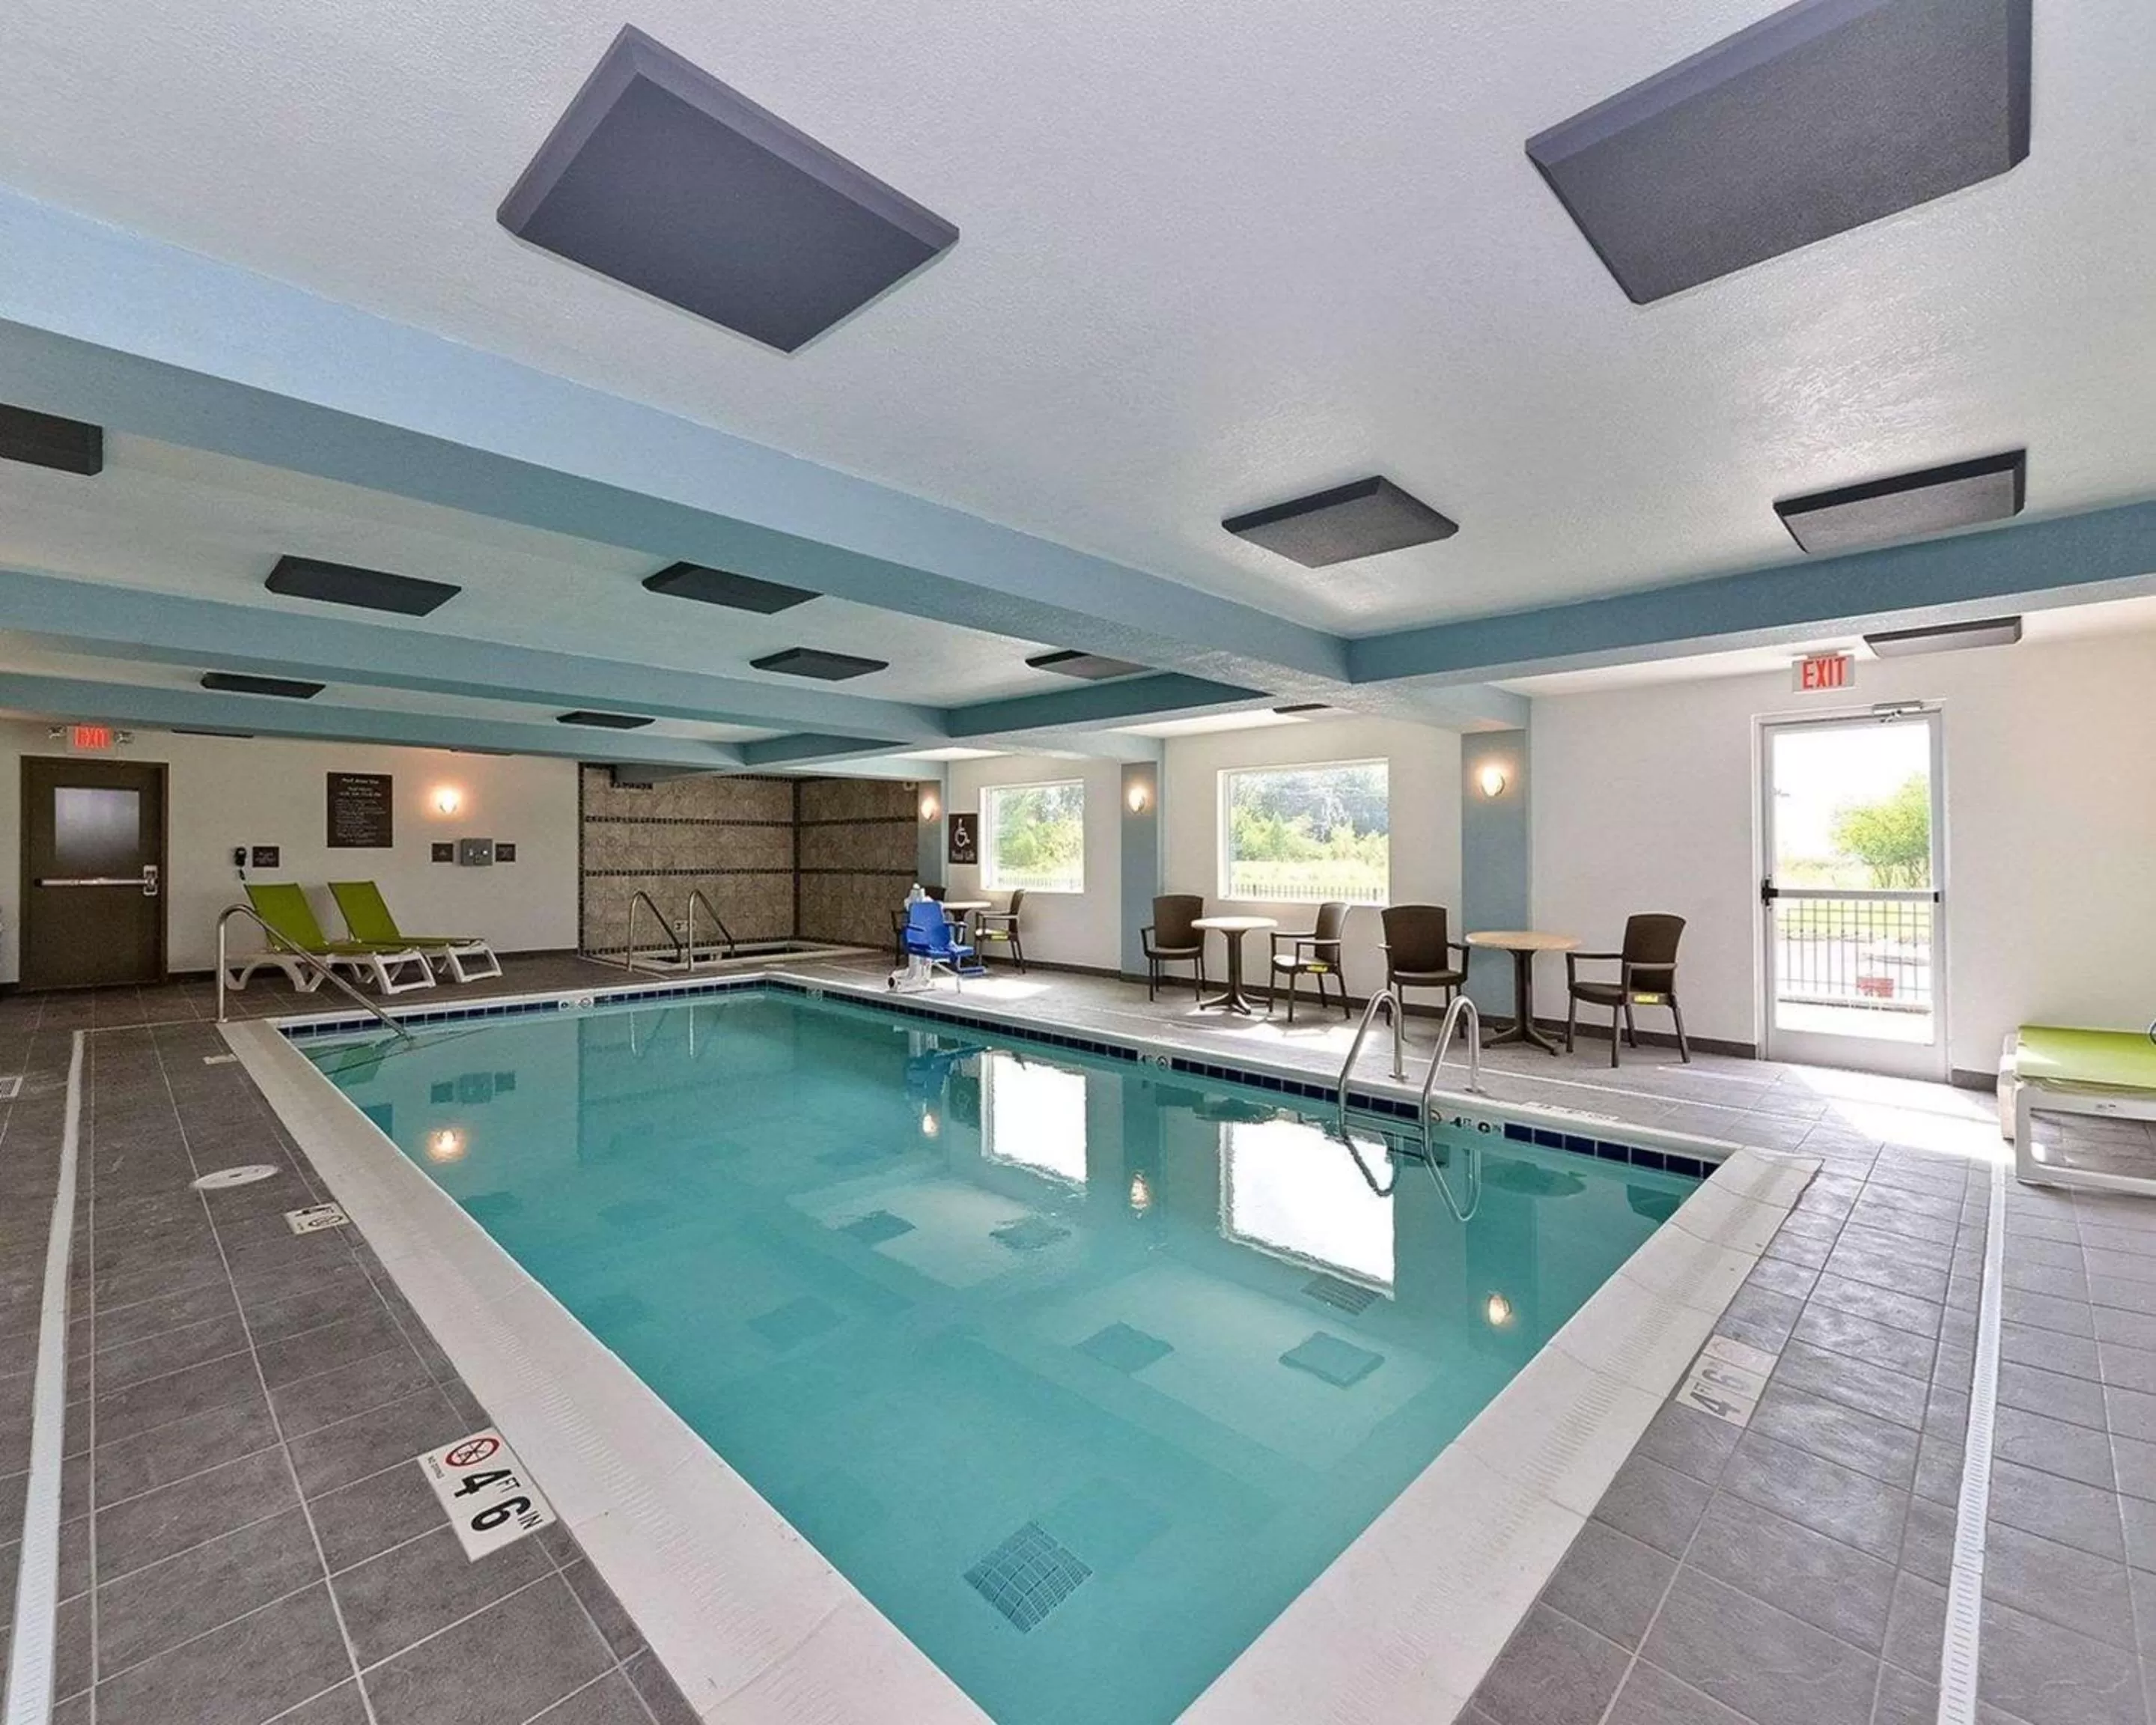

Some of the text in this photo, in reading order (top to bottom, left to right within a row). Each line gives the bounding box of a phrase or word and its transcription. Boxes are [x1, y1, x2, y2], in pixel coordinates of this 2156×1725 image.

[1802, 657, 1846, 689] EXIT
[75, 726, 109, 748] EXIT
[1690, 1391, 1741, 1417] 4
[454, 1469, 544, 1532] 4 FT 6 IN
